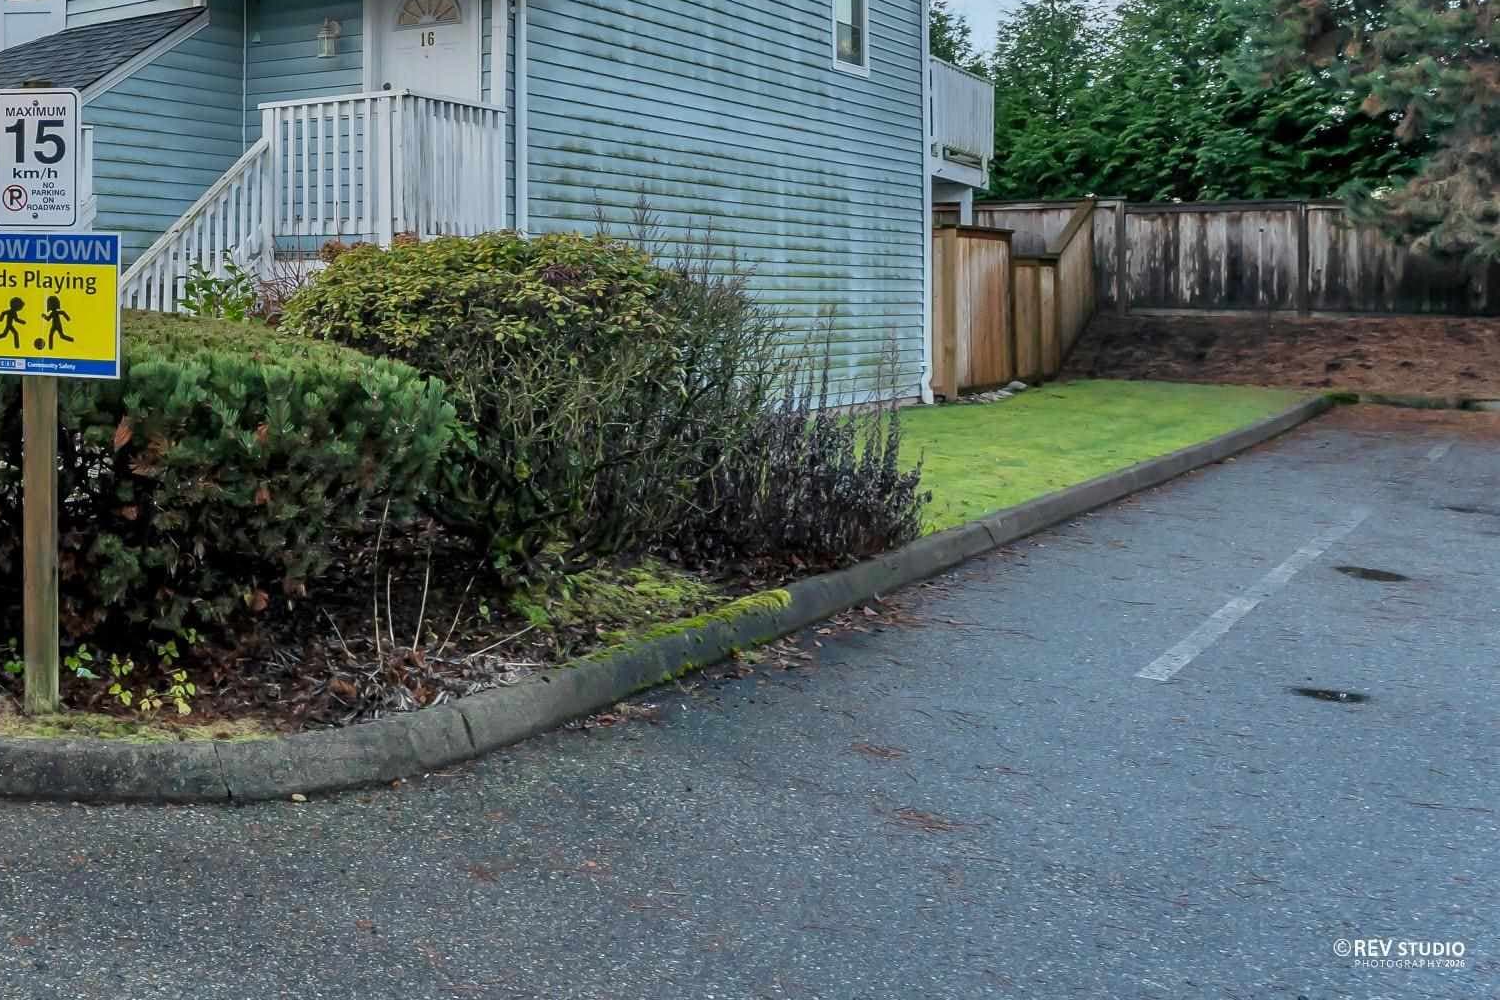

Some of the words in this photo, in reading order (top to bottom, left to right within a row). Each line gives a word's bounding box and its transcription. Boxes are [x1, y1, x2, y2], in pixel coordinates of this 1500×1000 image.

[421, 31, 434, 47] 16
[5, 106, 66, 117] MAXIMUM
[5, 118, 66, 164] 15
[12, 167, 58, 180] km/h
[35, 239, 111, 261] DOWN
[24, 270, 97, 295] Playing
[59, 362, 76, 371] Safety
